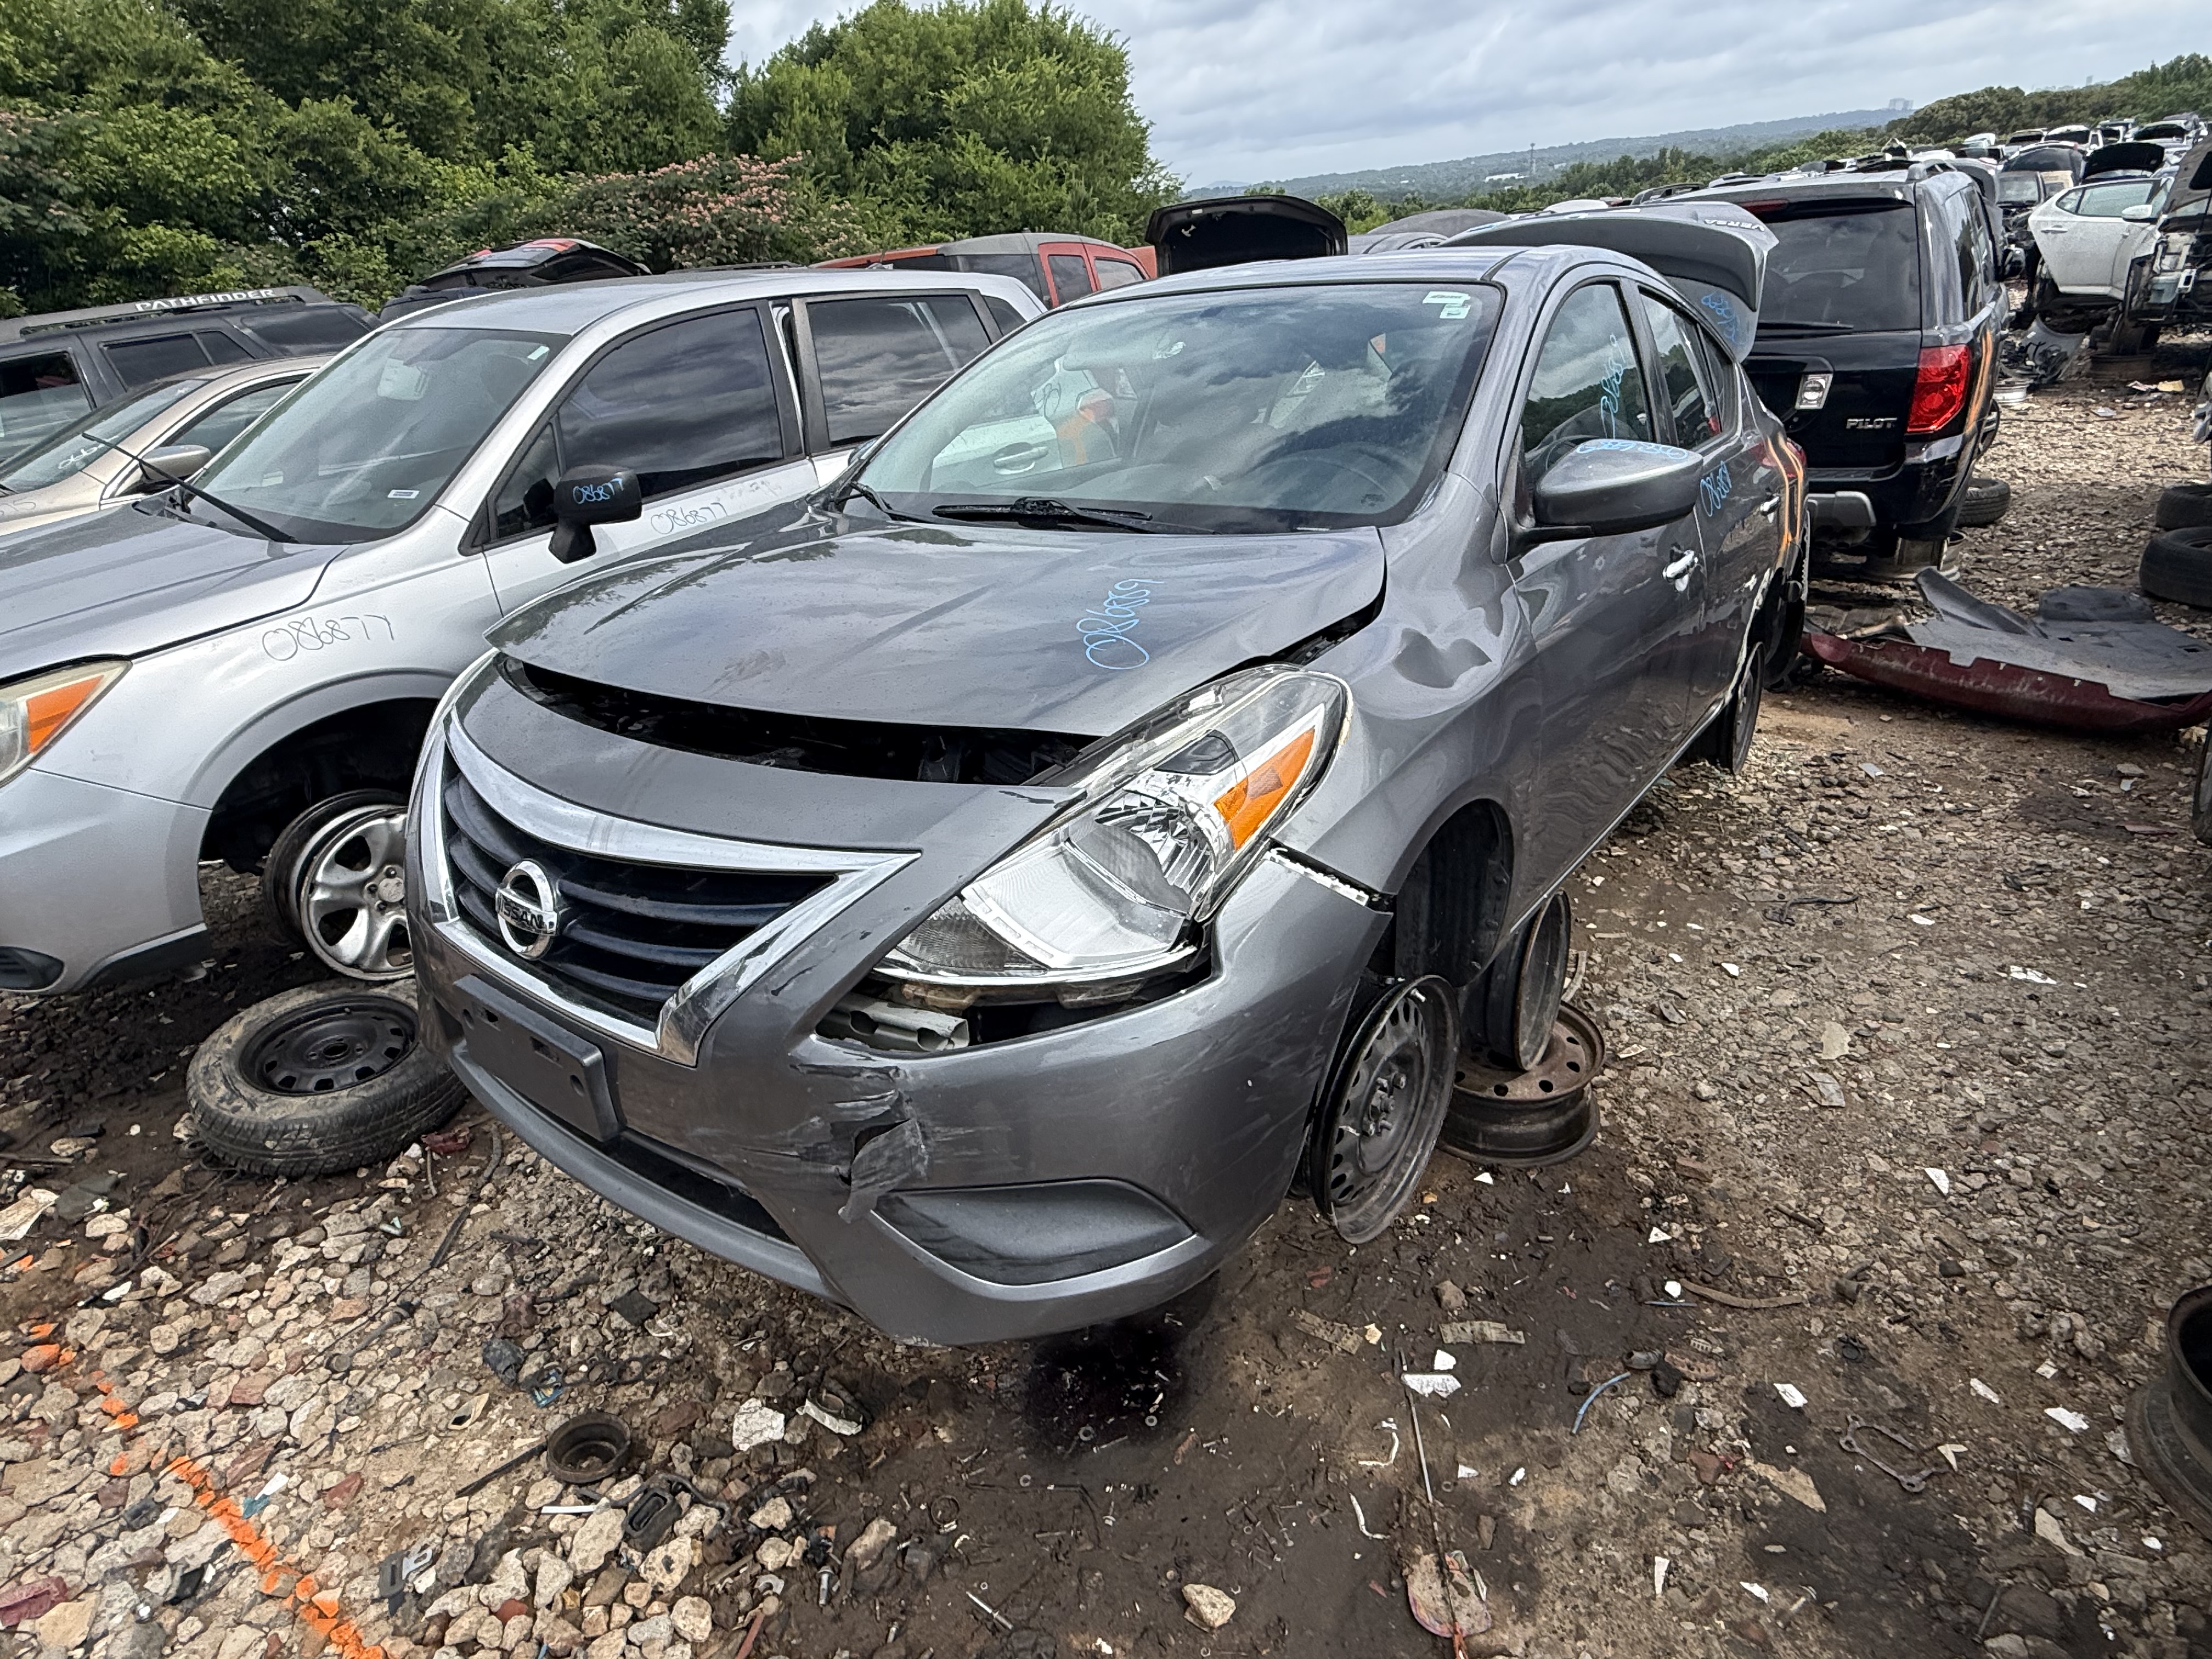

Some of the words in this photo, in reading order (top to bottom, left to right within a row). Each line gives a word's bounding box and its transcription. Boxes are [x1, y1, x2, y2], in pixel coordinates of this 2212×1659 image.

[136, 289, 276, 312] PATHFINDER
[1846, 417, 1898, 430] PILOT
[573, 477, 624, 505] 086877
[651, 502, 728, 535] 086877
[262, 614, 394, 662] 086877
